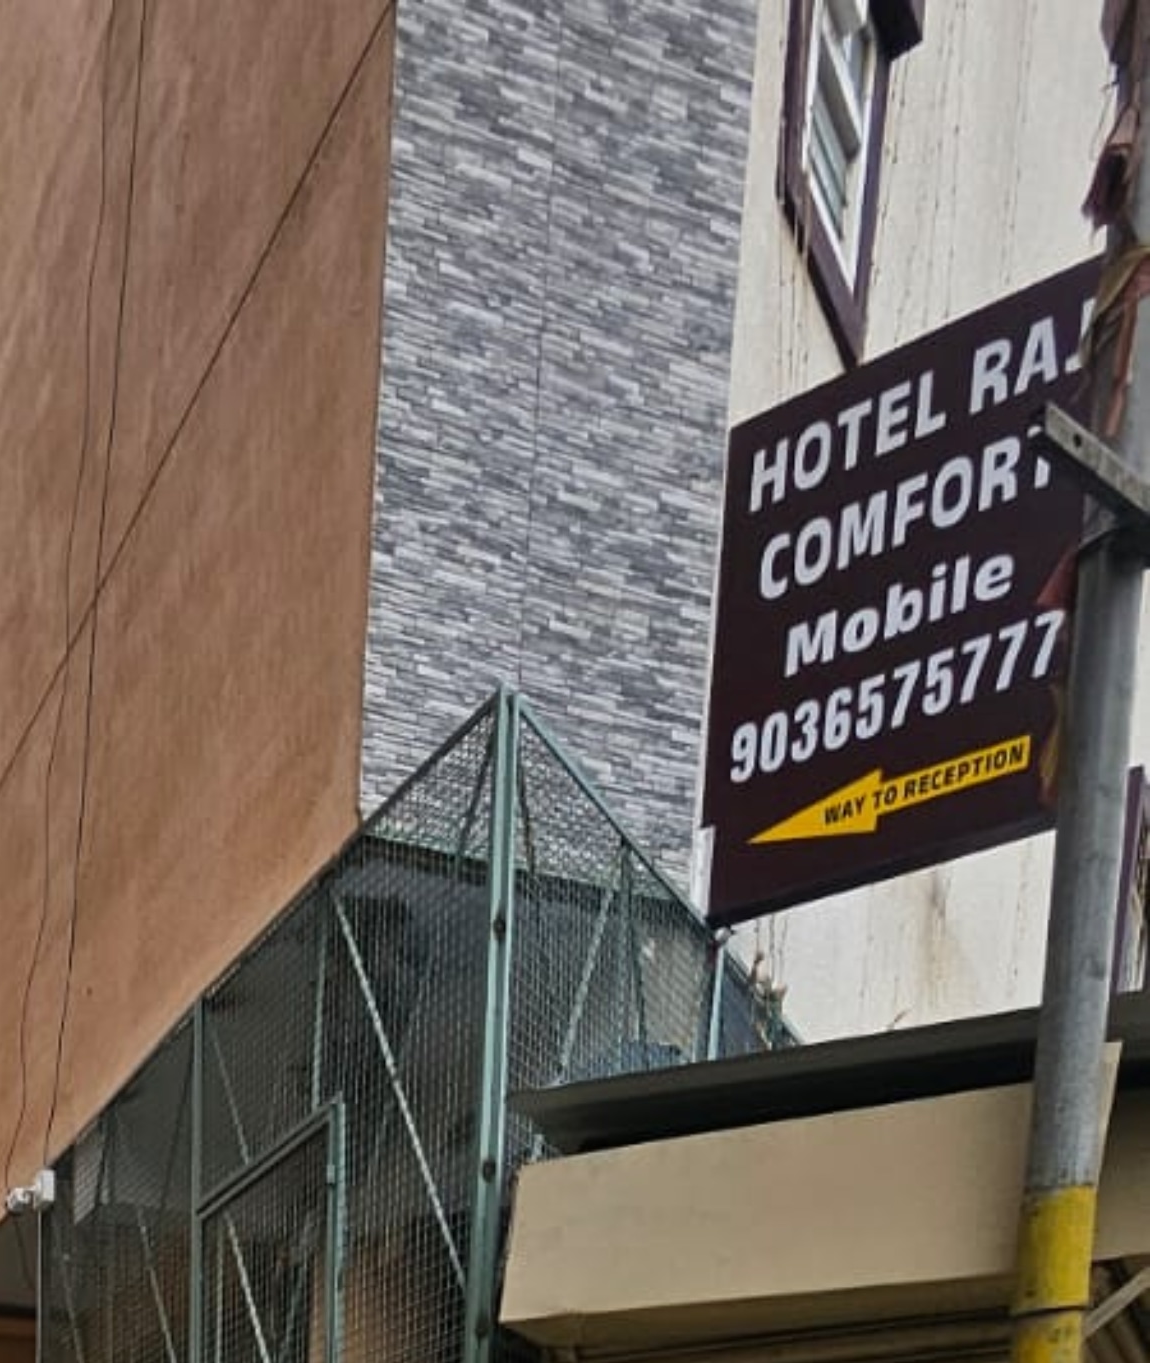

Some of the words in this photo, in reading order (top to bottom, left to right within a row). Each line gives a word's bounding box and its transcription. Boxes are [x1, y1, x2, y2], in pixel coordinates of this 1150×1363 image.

[750, 370, 947, 511] HOTEL
[784, 554, 1014, 677] Mobile
[730, 609, 1066, 783] 9036575777
[824, 796, 866, 826] WAY
[873, 785, 898, 810] TO
[903, 744, 1025, 799] RECEPTION
